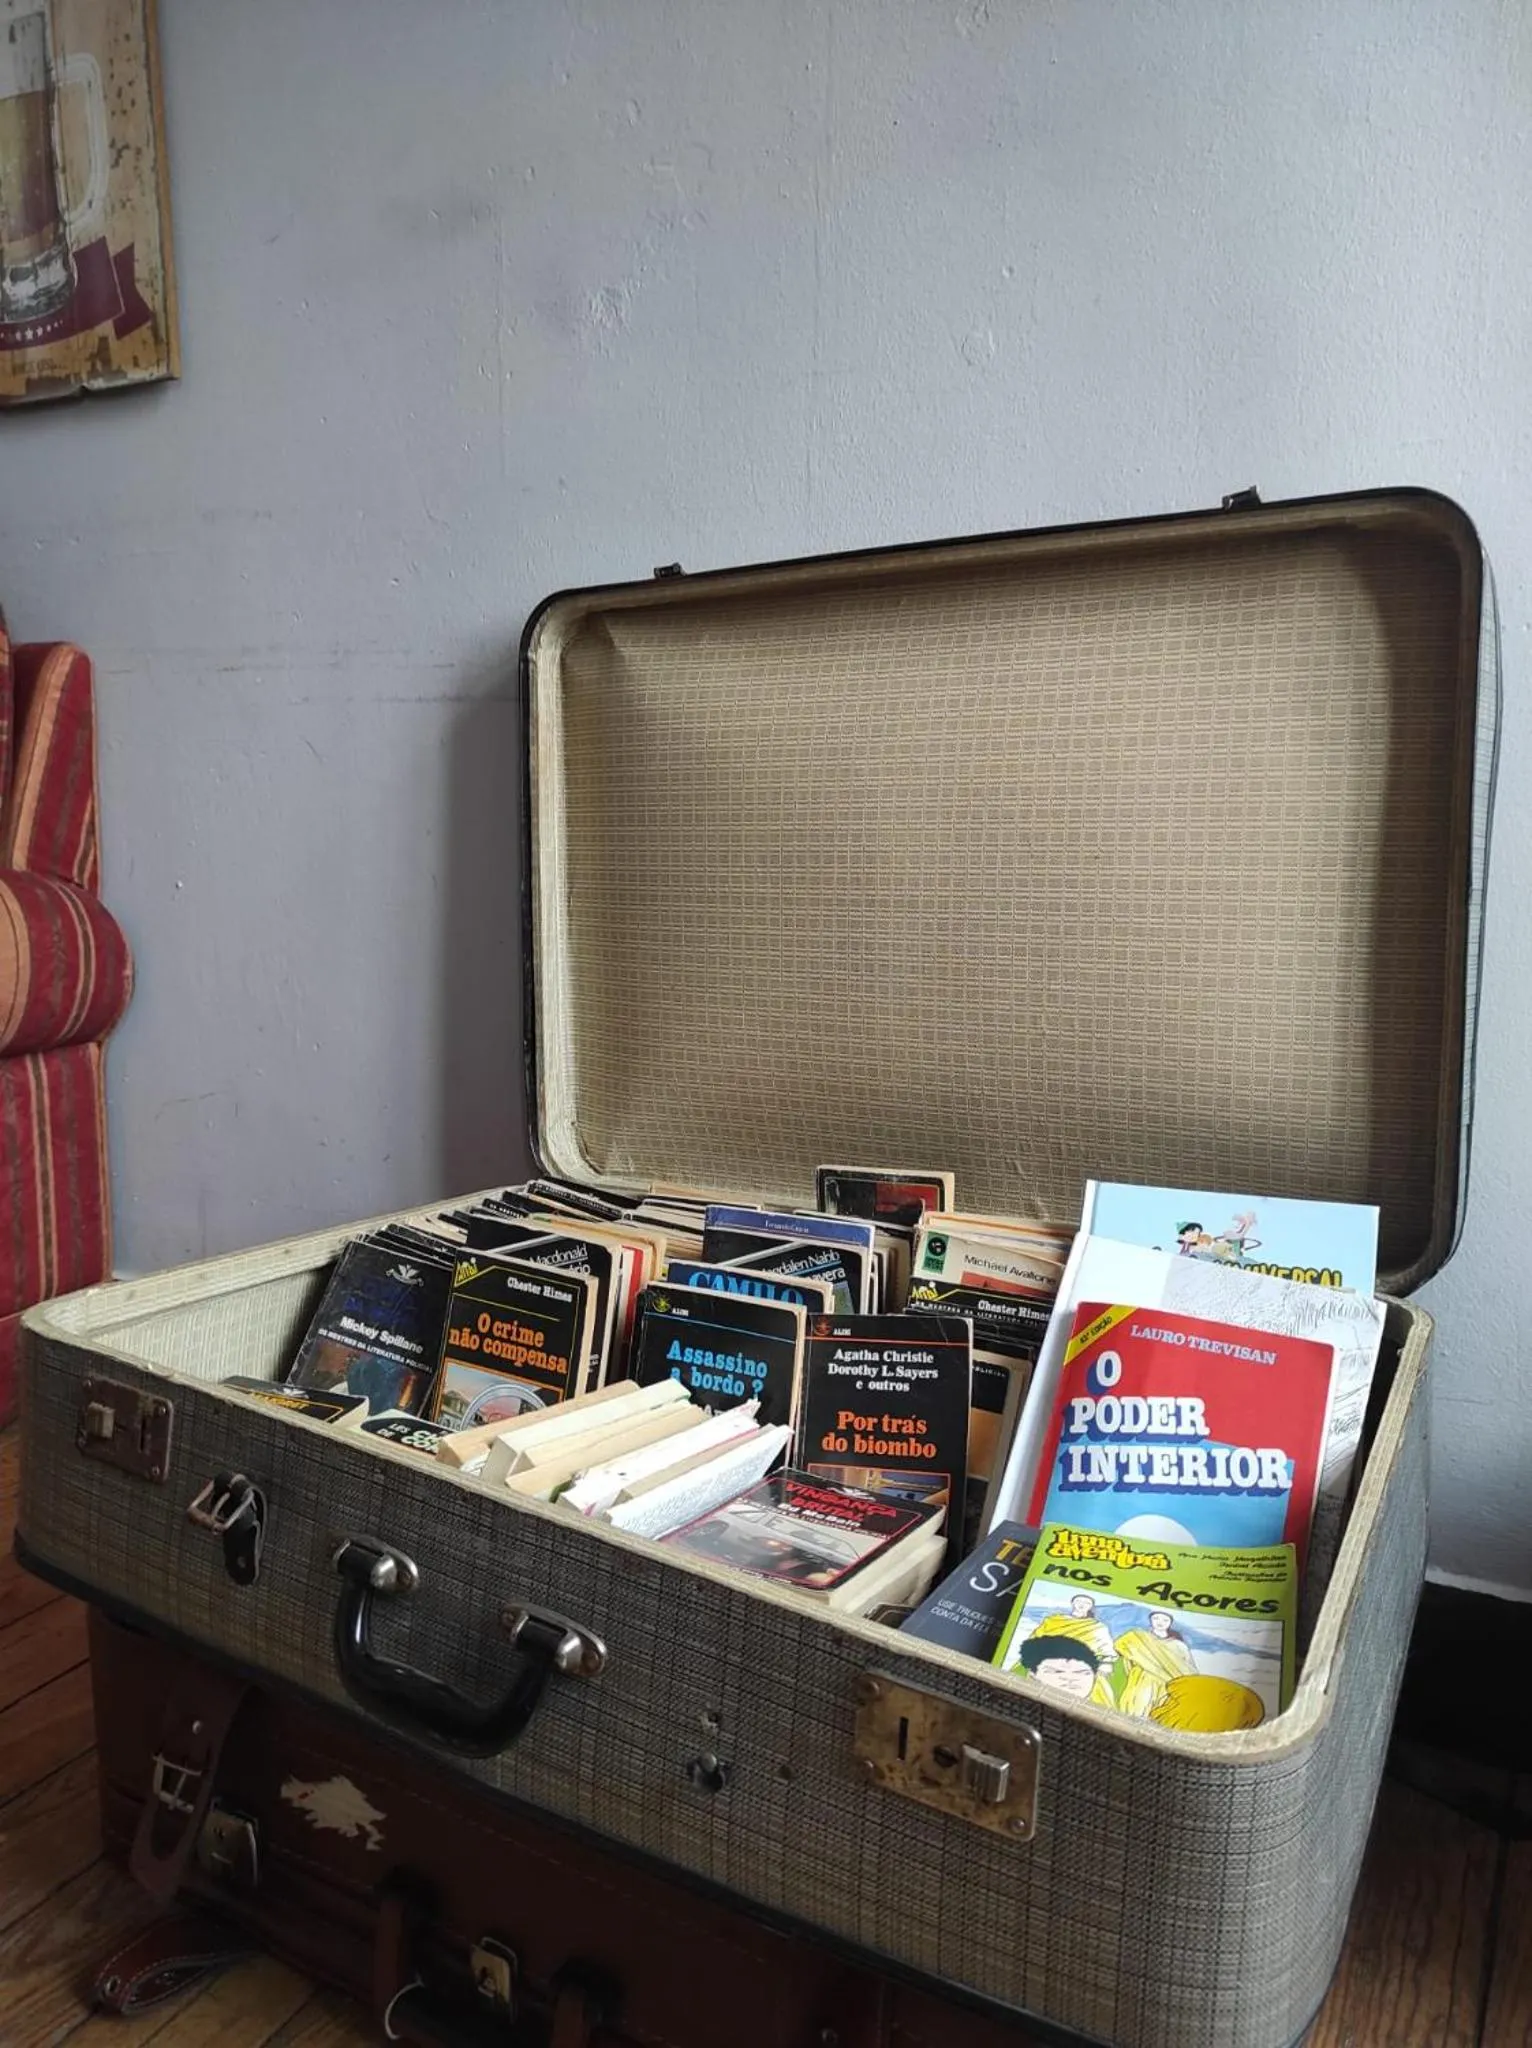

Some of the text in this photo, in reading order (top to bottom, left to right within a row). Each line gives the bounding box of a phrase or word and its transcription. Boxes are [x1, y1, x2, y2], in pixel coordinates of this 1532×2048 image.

[763, 1249, 841, 1274] agdalen Nabb
[963, 1254, 1008, 1273] Michael
[507, 1276, 573, 1303] Chester Himes
[977, 1300, 1017, 1315] Chester
[340, 1316, 424, 1354] Mickey Spillane
[477, 1312, 545, 1348] O crime
[1131, 1324, 1278, 1366] LAURO TREVISAN
[449, 1327, 480, 1350] não
[483, 1338, 568, 1375] compensa
[666, 1340, 768, 1378] Assassino
[833, 1349, 934, 1364] Agatha Christie
[691, 1367, 745, 1397] bordo
[827, 1363, 879, 1378] Dorothy
[895, 1365, 939, 1380] Sayers
[1095, 1350, 1122, 1387] O
[856, 1379, 910, 1392] e outros
[836, 1410, 927, 1435] Por trás
[1069, 1395, 1211, 1436] PODER
[821, 1432, 937, 1459] do biombo
[1067, 1445, 1293, 1489] INTERIOR
[995, 1538, 1034, 1568] TE
[1043, 1563, 1280, 1613] nos Açores
